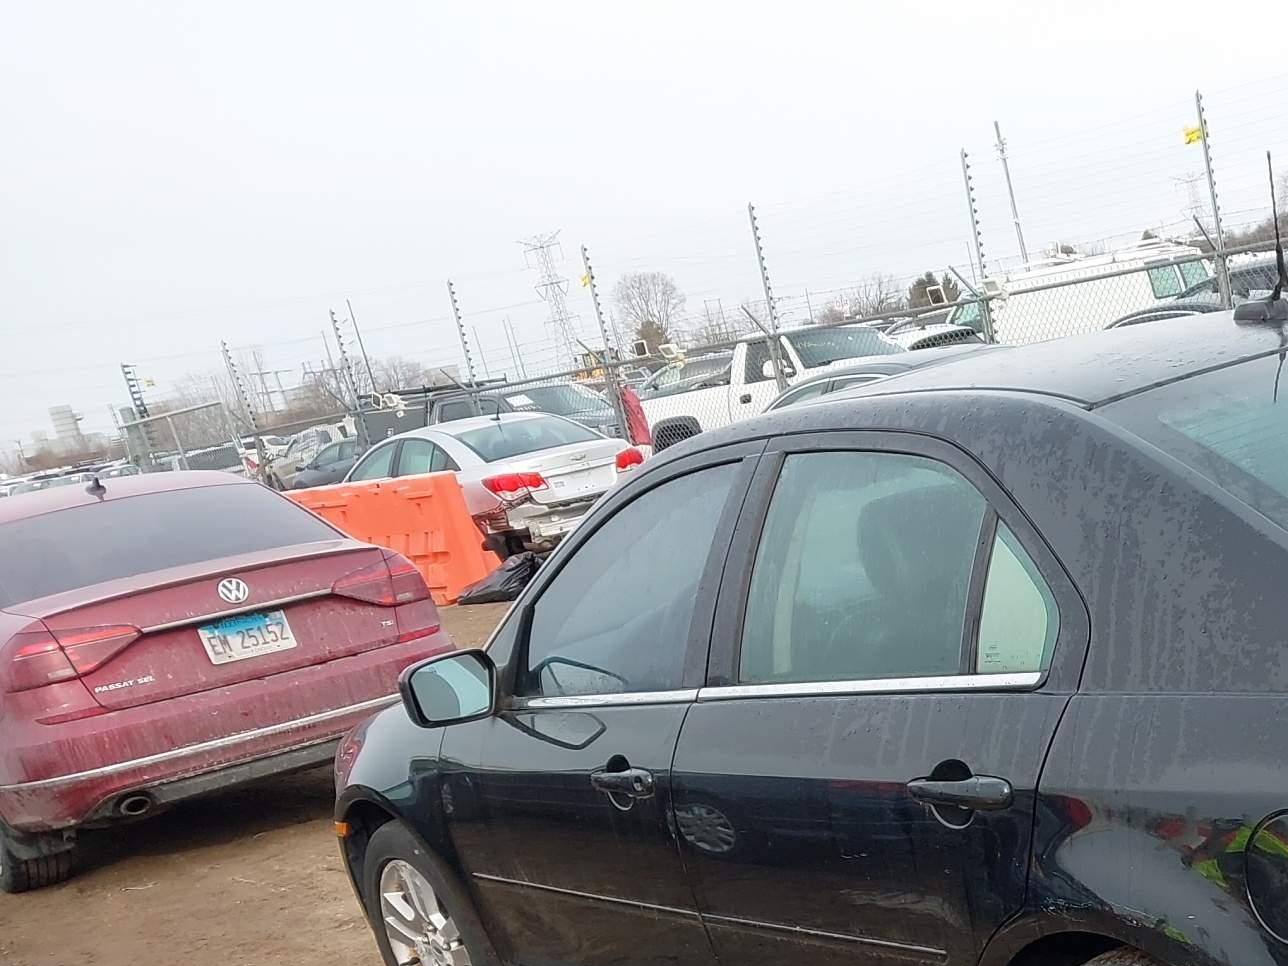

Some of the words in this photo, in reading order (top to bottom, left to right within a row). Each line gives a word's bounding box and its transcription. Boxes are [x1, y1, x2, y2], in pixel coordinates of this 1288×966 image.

[236, 621, 290, 650] 25152
[94, 679, 135, 694] PASSAT
[137, 674, 156, 685] SEL
